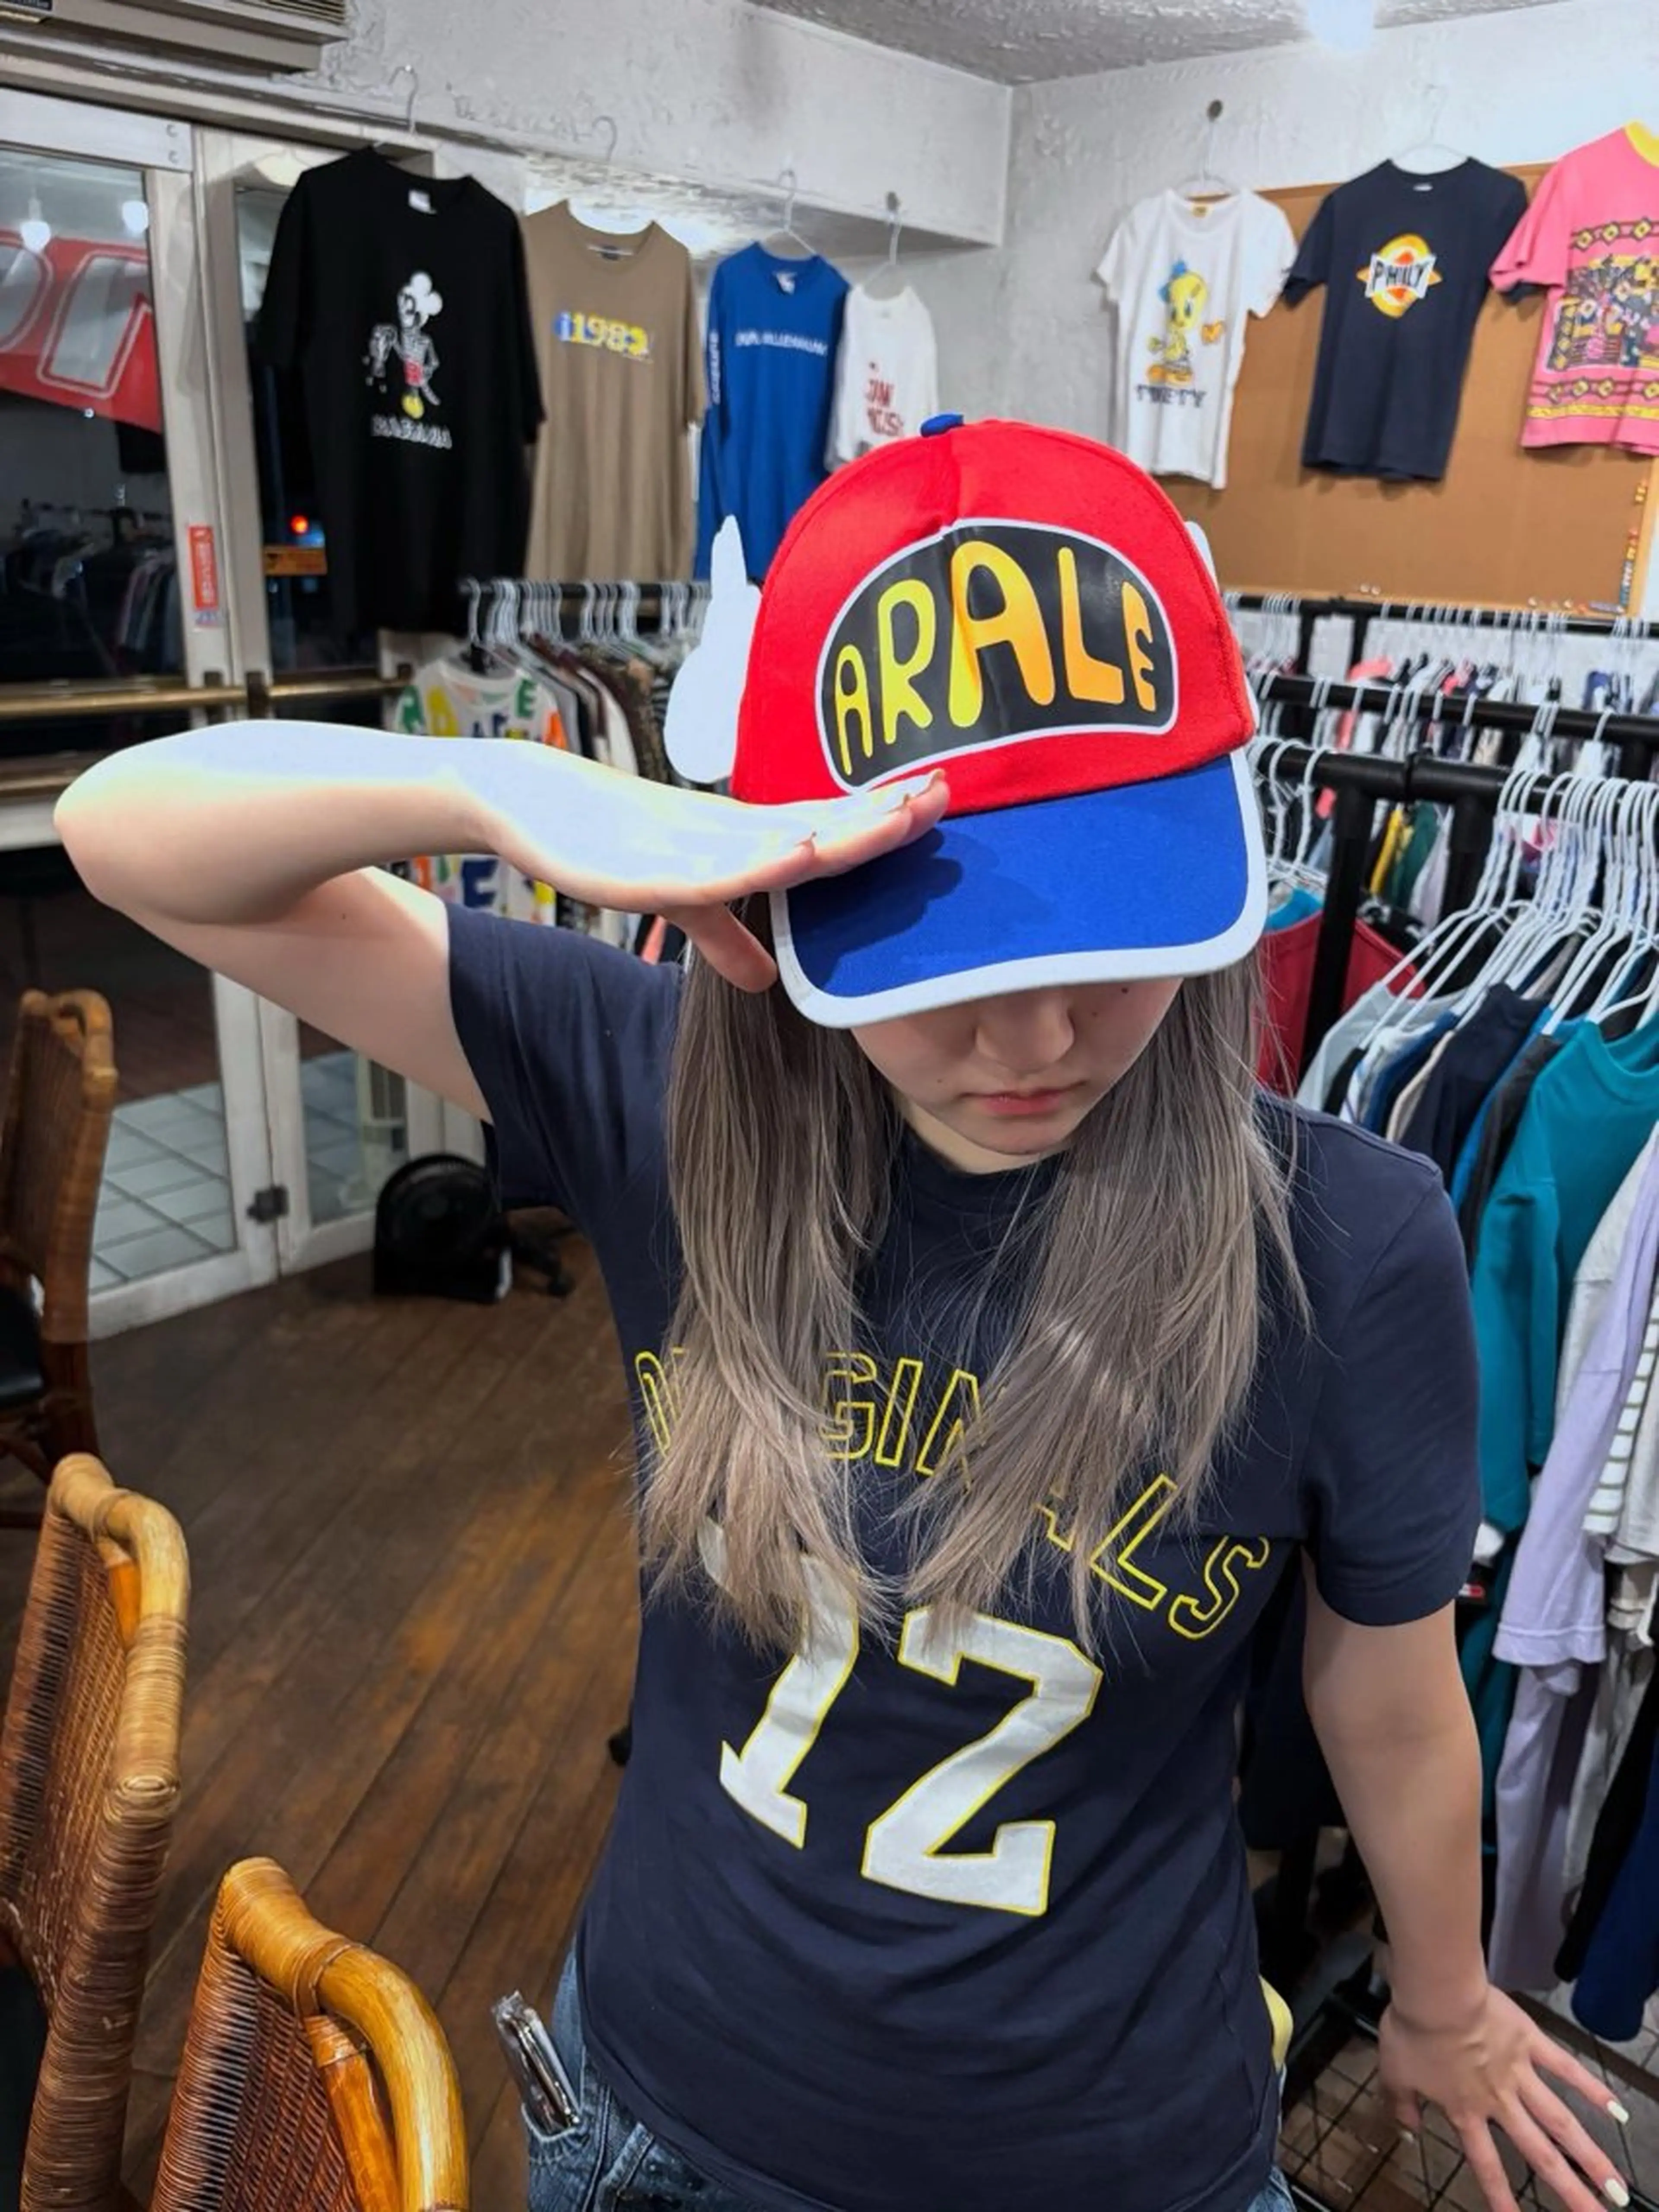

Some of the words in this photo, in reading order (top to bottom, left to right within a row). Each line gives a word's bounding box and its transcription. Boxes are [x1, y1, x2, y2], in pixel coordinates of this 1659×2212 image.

[834, 540, 1157, 776] ARALE
[635, 1347, 1269, 1639] OGINLS
[697, 1514, 1104, 1917] 12
